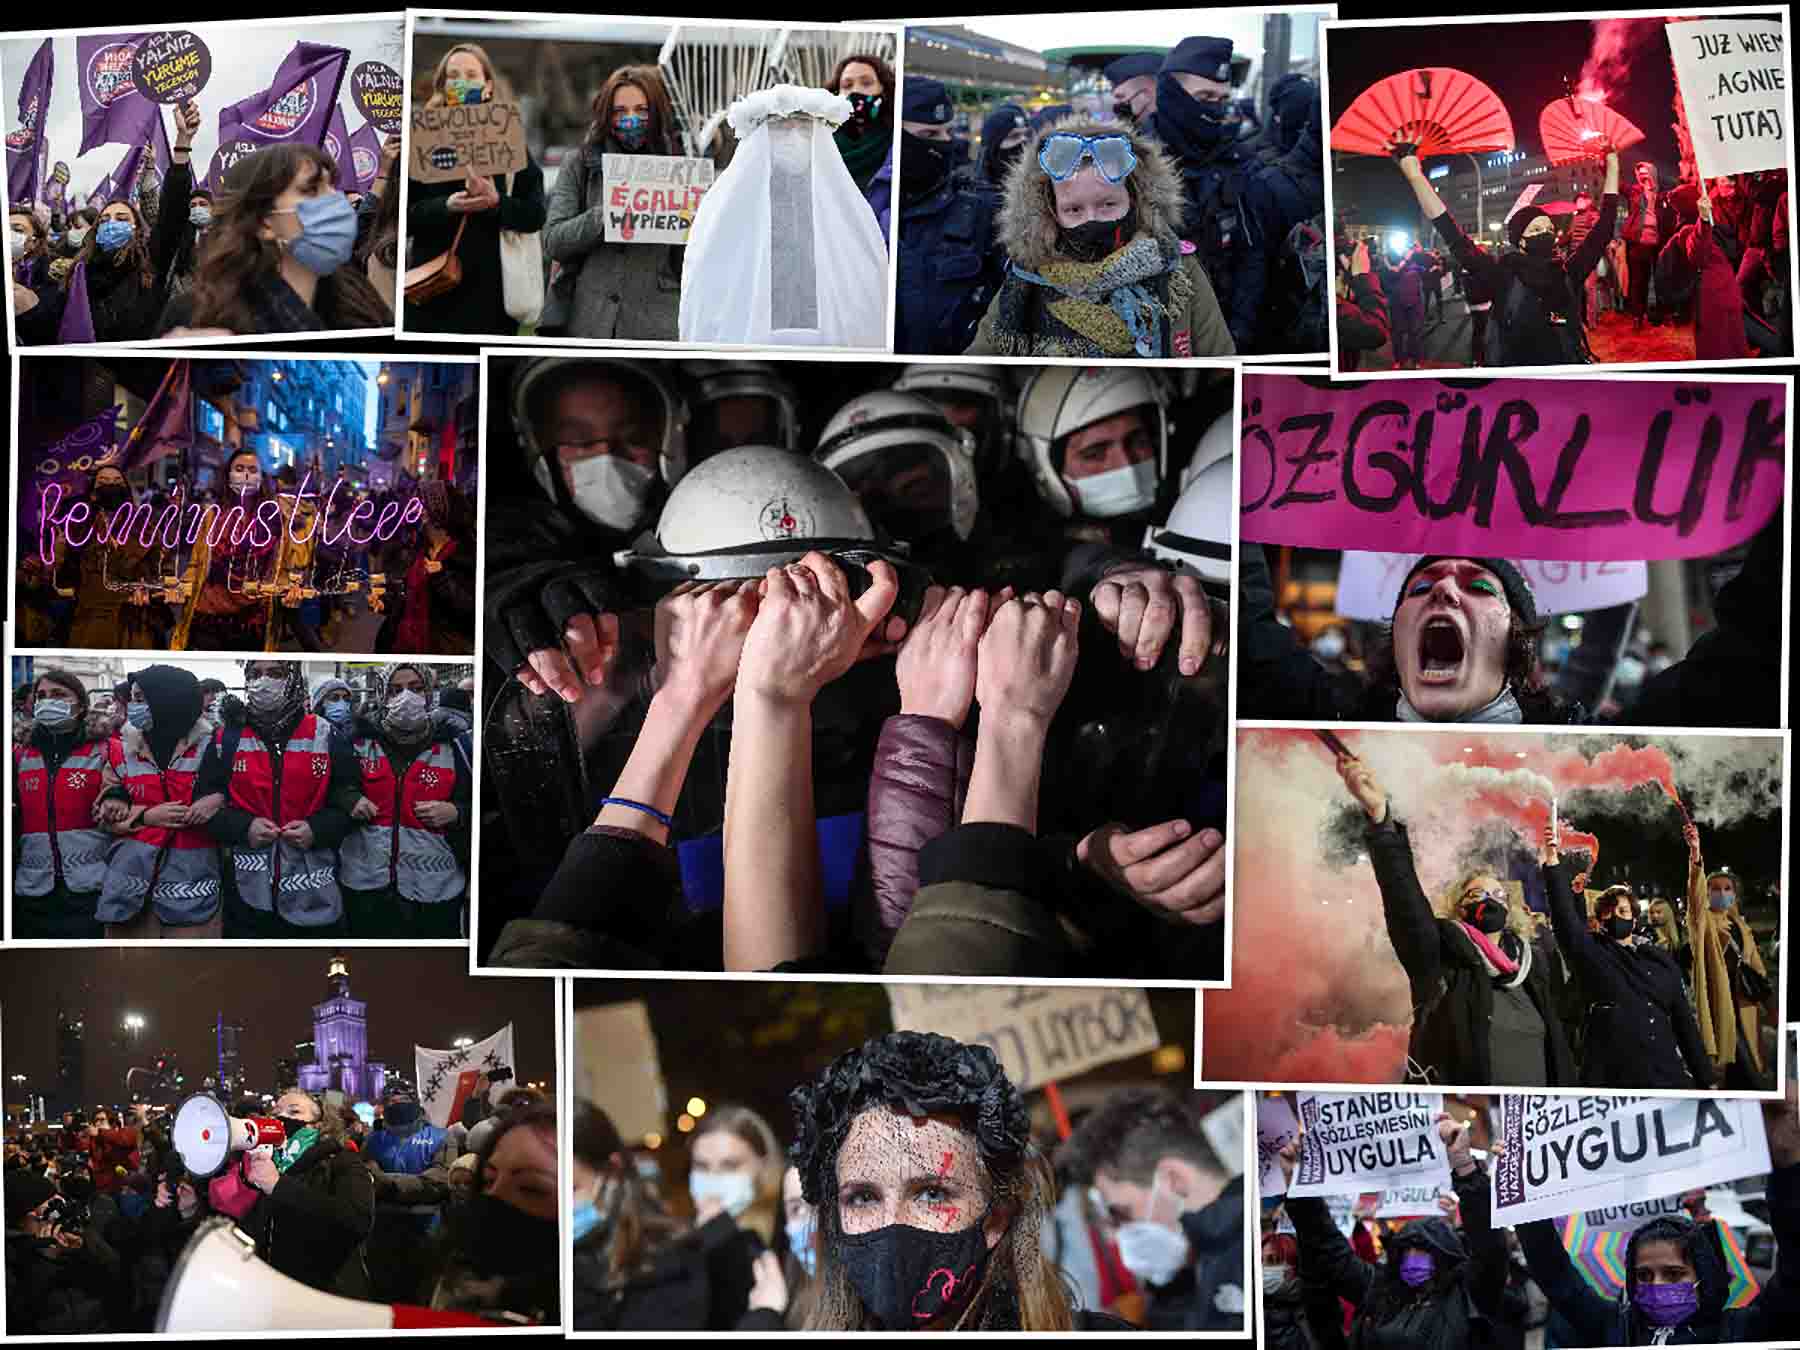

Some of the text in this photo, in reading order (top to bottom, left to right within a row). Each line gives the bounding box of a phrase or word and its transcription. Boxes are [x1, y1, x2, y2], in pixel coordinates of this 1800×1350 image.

[136, 34, 195, 69] YALNIZ
[1711, 109, 1783, 141] TUTAJ
[609, 181, 706, 212] ÉGALIT
[610, 211, 692, 231] WYPIERD
[1525, 1095, 1653, 1141] SÖZLEŞM
[1327, 1134, 1436, 1175] UYGULA
[1526, 1098, 1735, 1187] UYGULA
